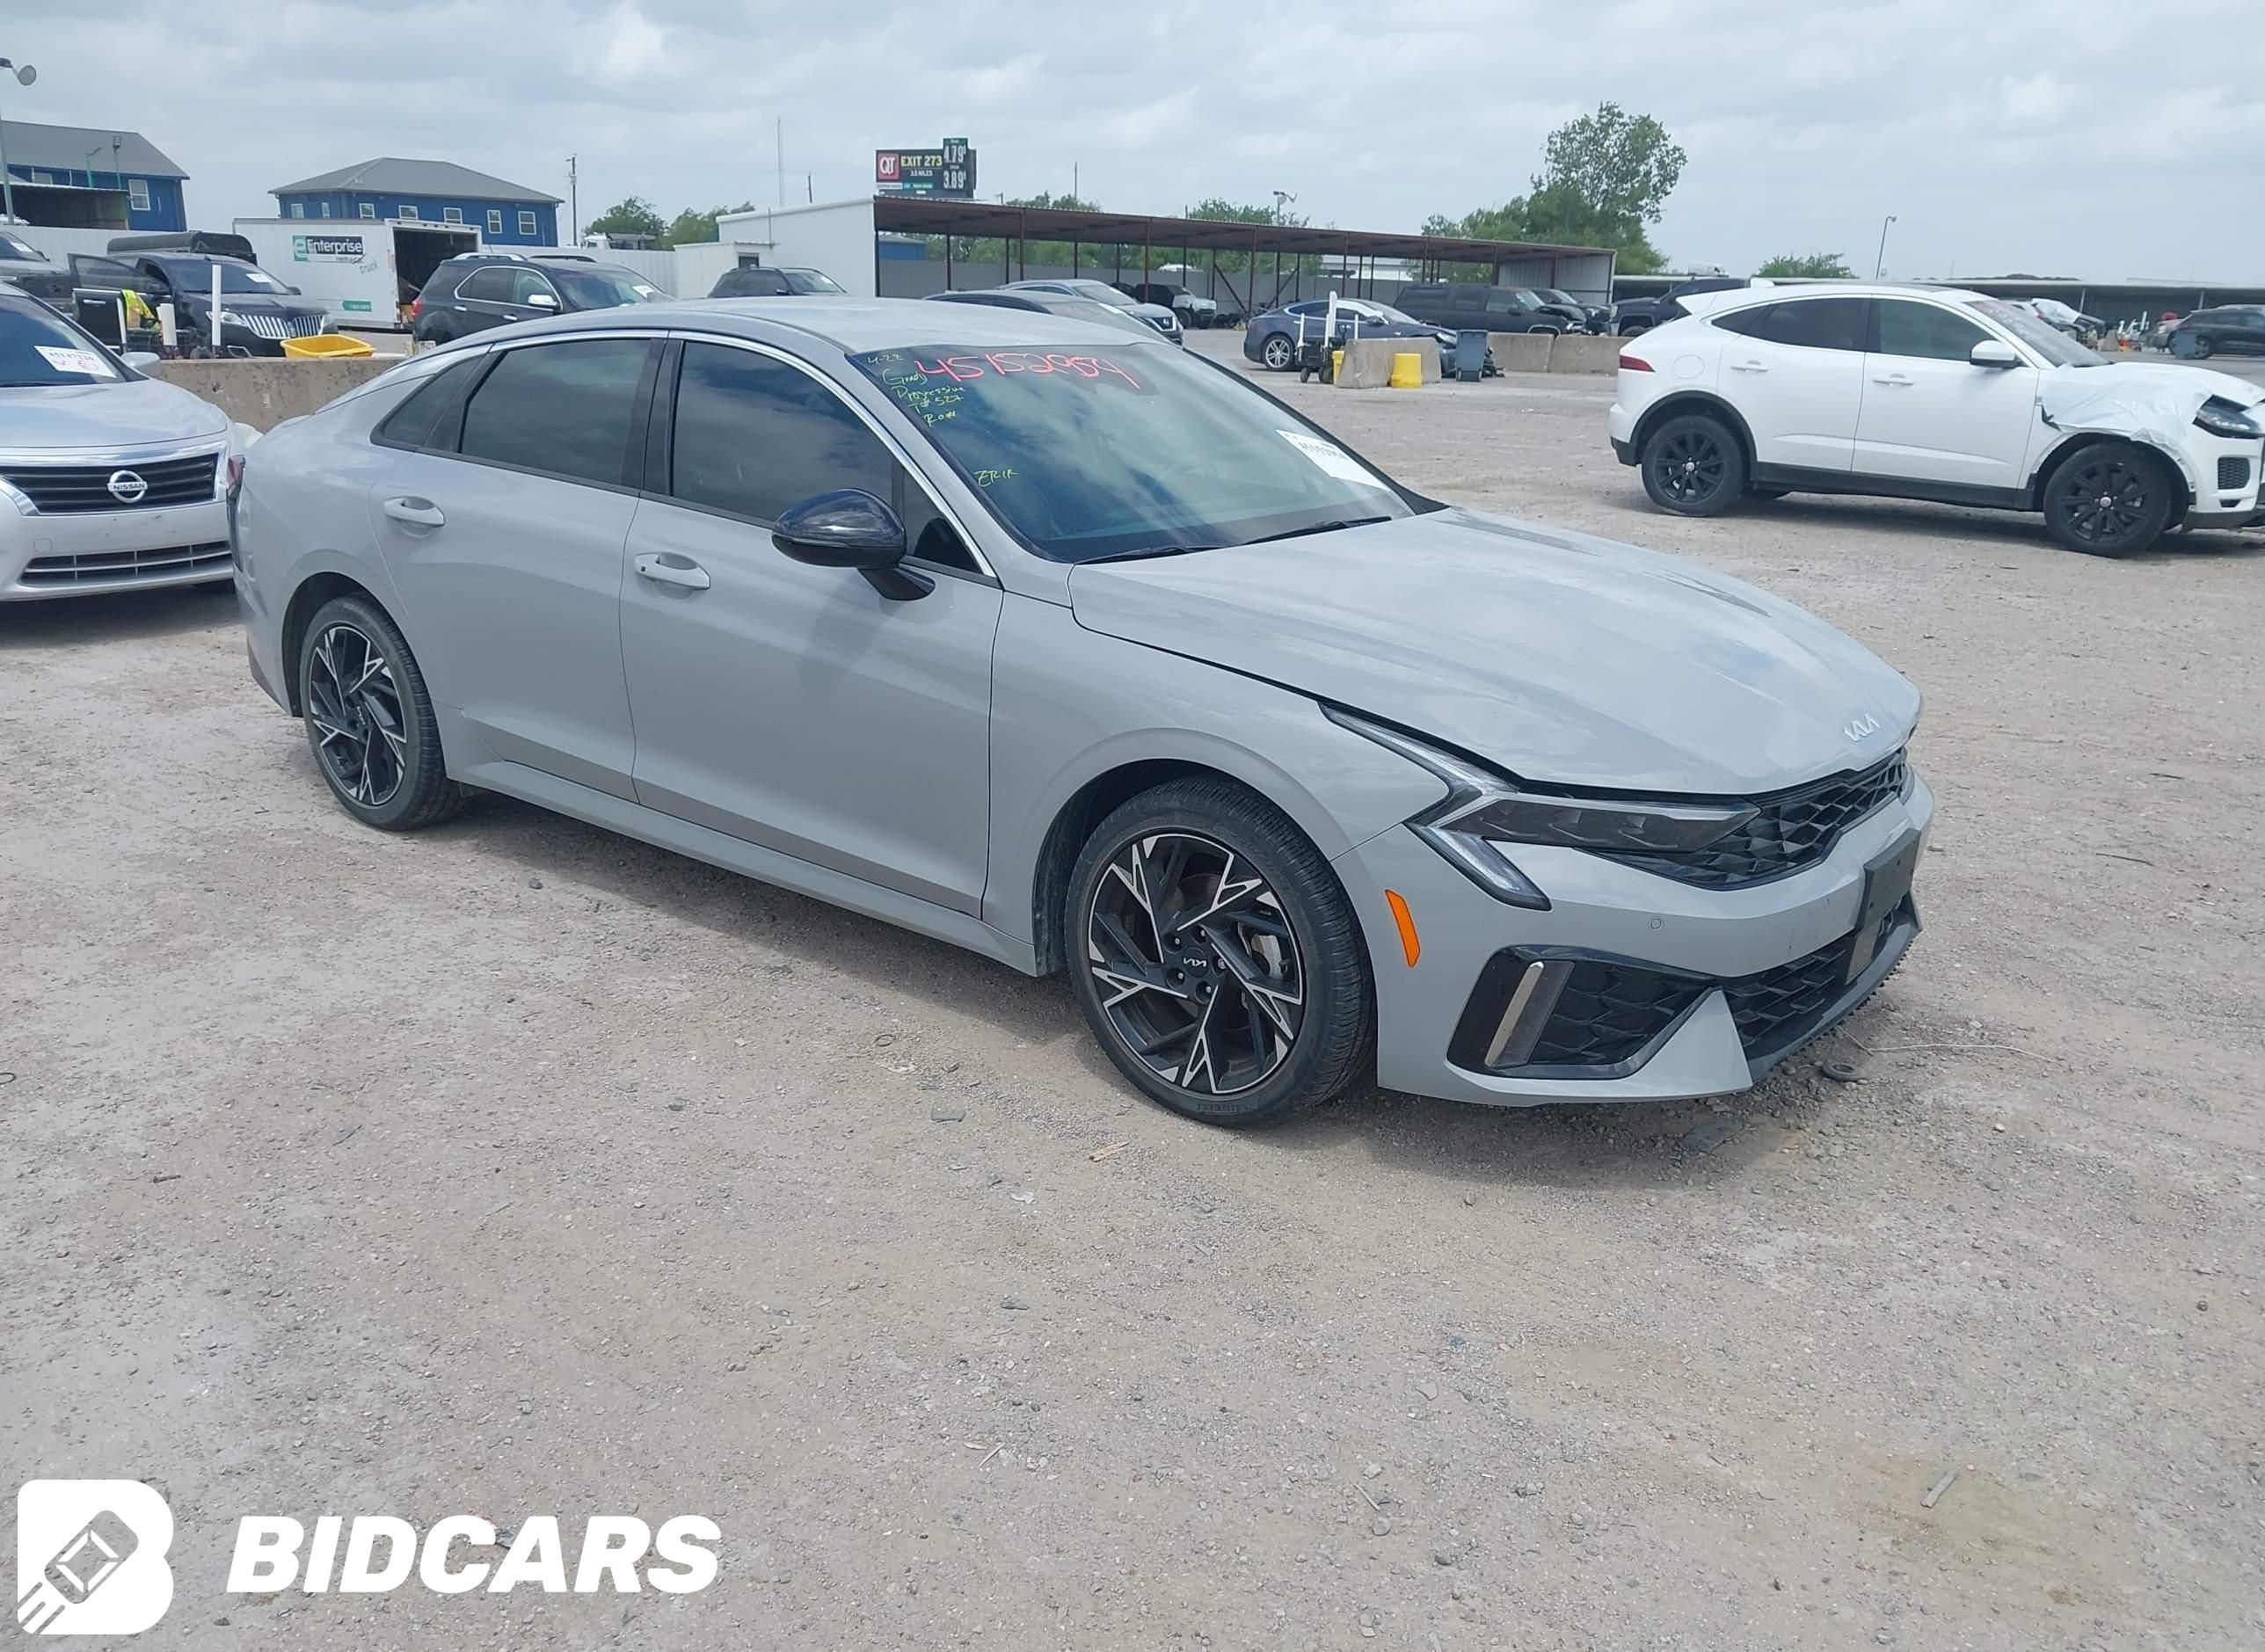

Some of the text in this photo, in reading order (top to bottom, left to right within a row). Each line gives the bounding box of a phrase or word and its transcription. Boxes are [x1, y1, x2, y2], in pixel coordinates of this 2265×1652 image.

[880, 156, 895, 175] QT
[900, 155, 943, 167] EXIT 273
[307, 238, 362, 255] Enterprise
[1843, 713, 1880, 742] KIA
[1183, 957, 1207, 967] KIA
